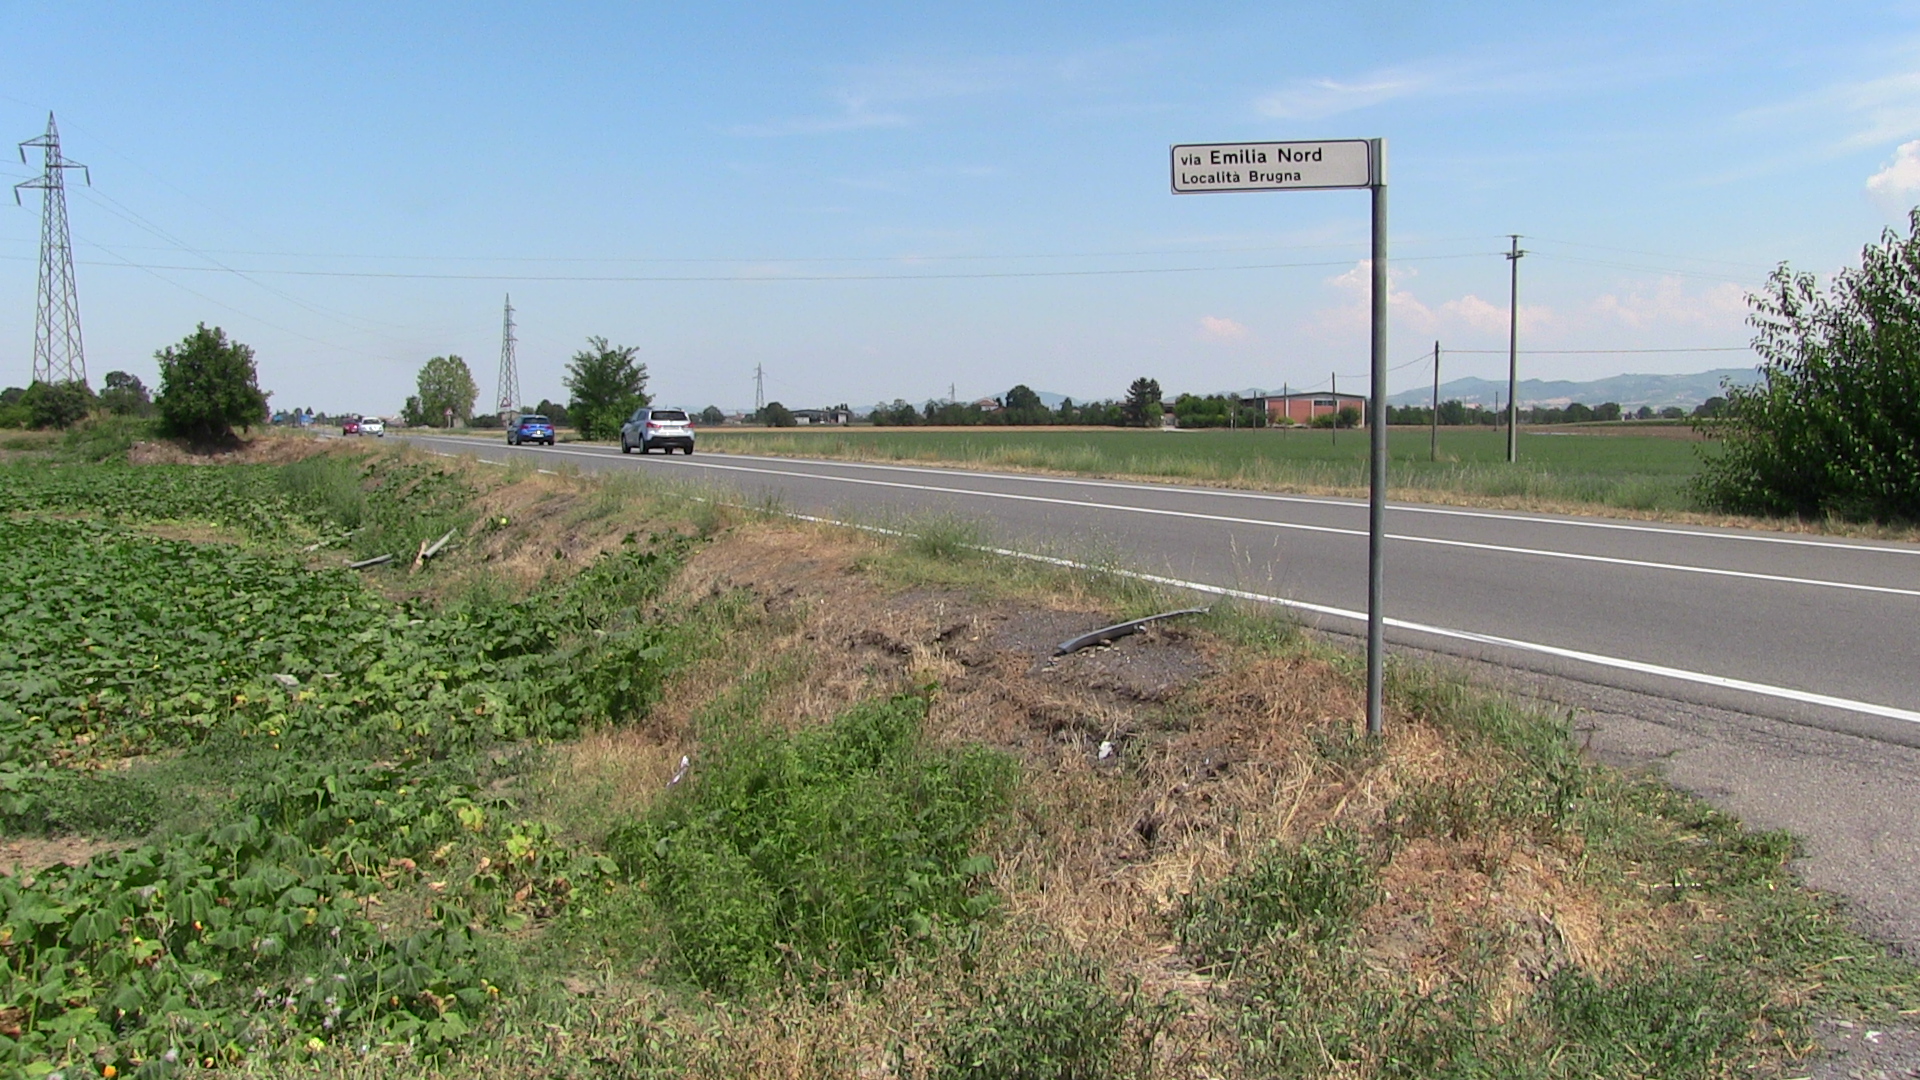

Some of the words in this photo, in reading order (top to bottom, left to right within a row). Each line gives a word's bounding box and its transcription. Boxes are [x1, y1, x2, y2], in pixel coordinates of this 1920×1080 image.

[1180, 153, 1201, 166] via
[1210, 148, 1267, 165] Emilia
[1277, 147, 1322, 163] Nord
[1181, 170, 1240, 185] Località
[1248, 170, 1302, 184] Brugna
